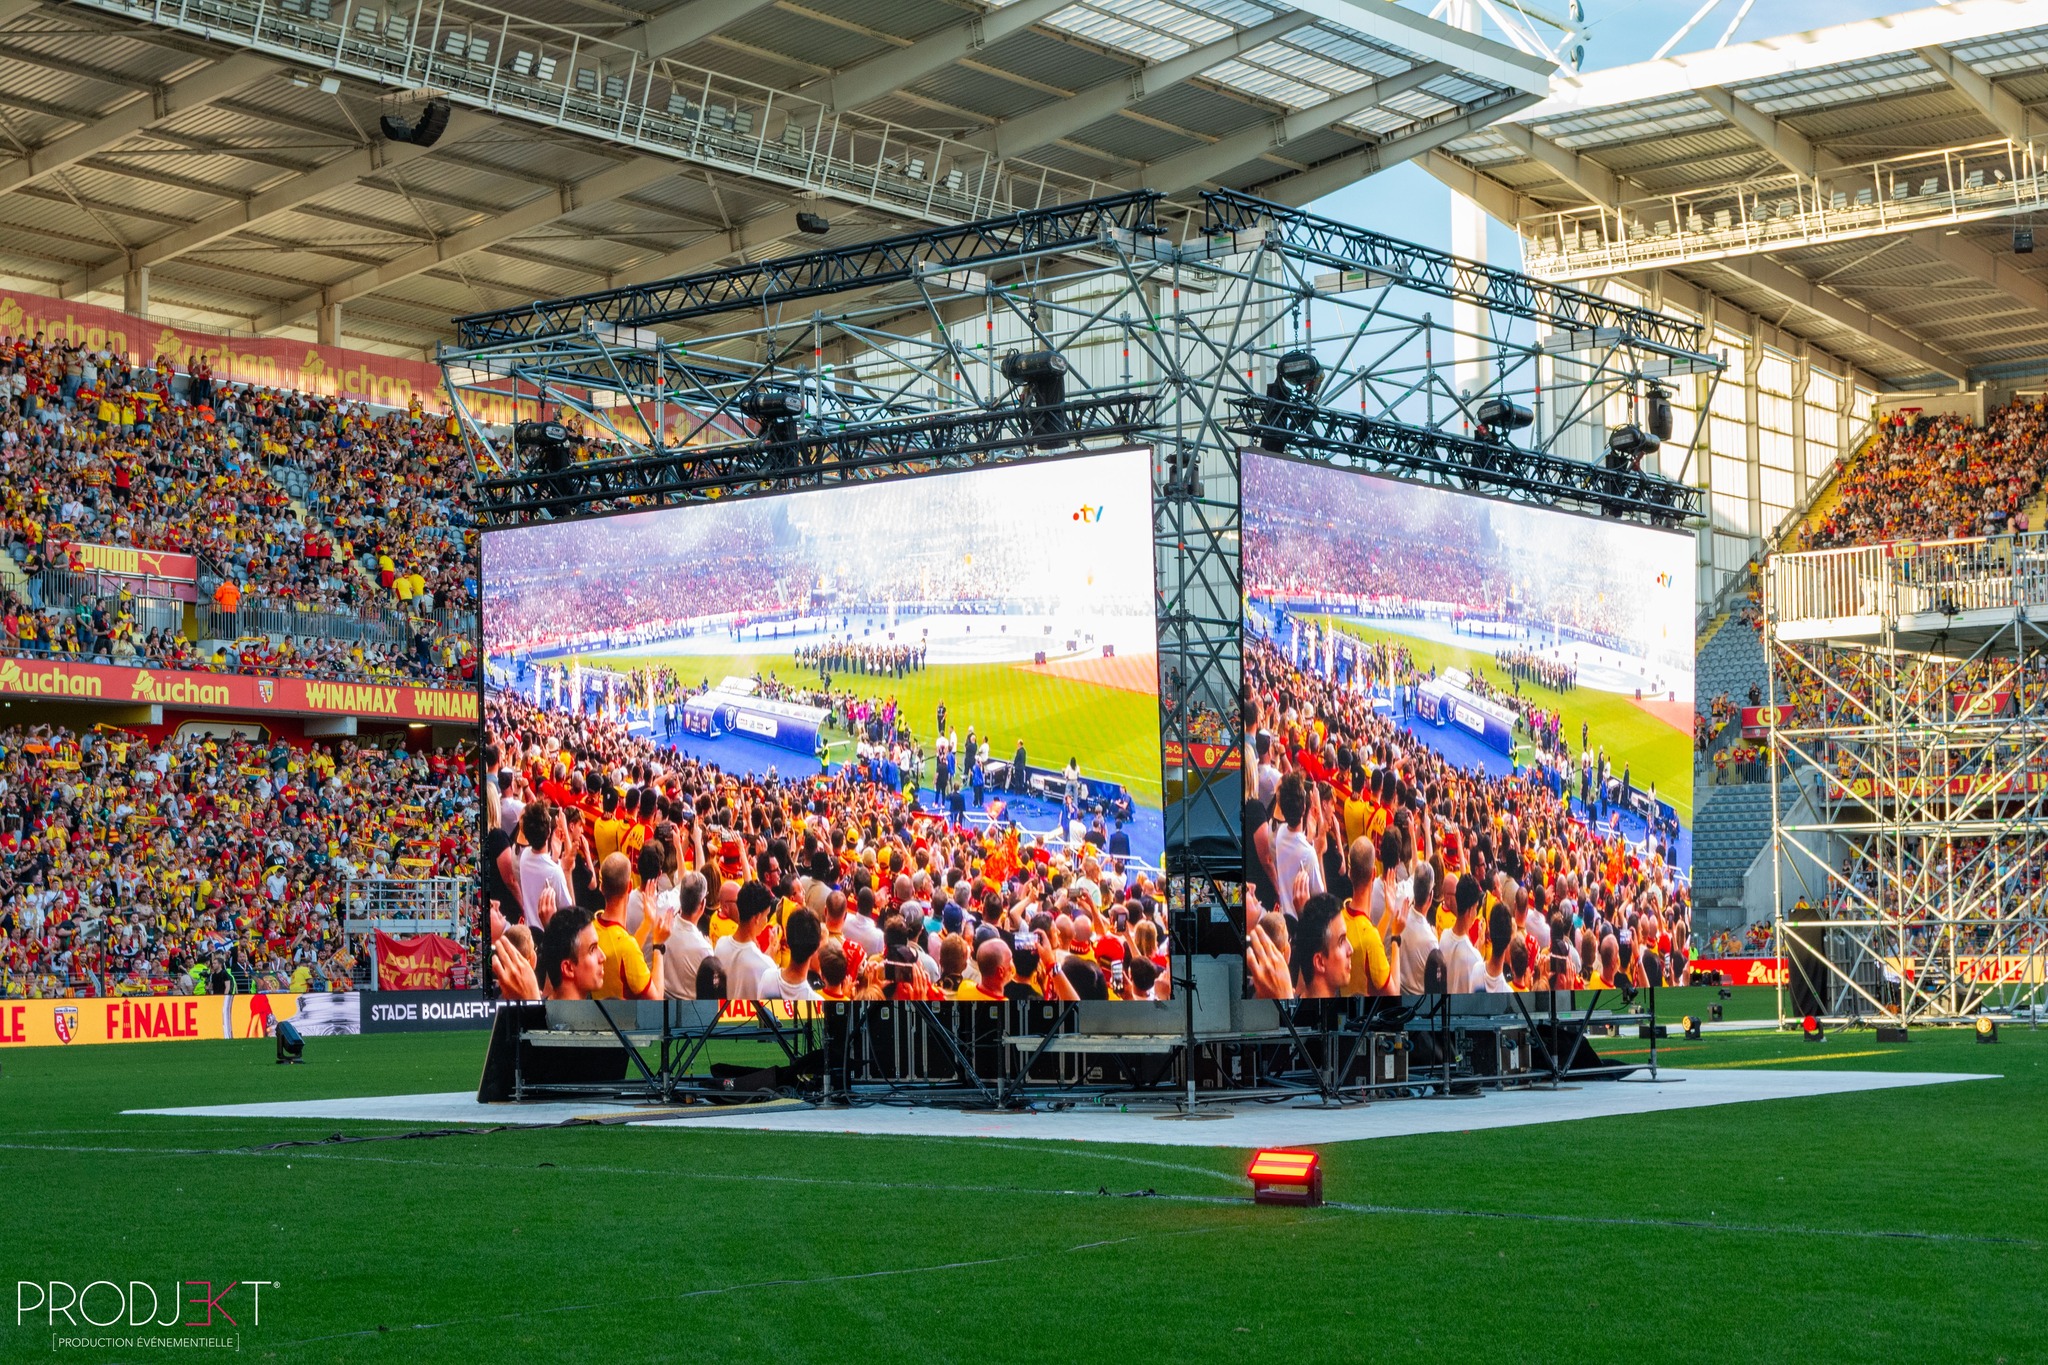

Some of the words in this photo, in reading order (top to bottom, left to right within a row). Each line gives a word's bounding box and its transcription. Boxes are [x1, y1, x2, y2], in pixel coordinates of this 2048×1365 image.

[0, 297, 127, 357] Auchan
[300, 350, 412, 399] Auchan
[80, 545, 139, 573] PUMA
[0, 659, 102, 696] Auchan
[131, 670, 229, 705] Auchan
[306, 682, 398, 714] WINAMAX
[414, 690, 479, 719] WINAM
[371, 1004, 418, 1021] STADE
